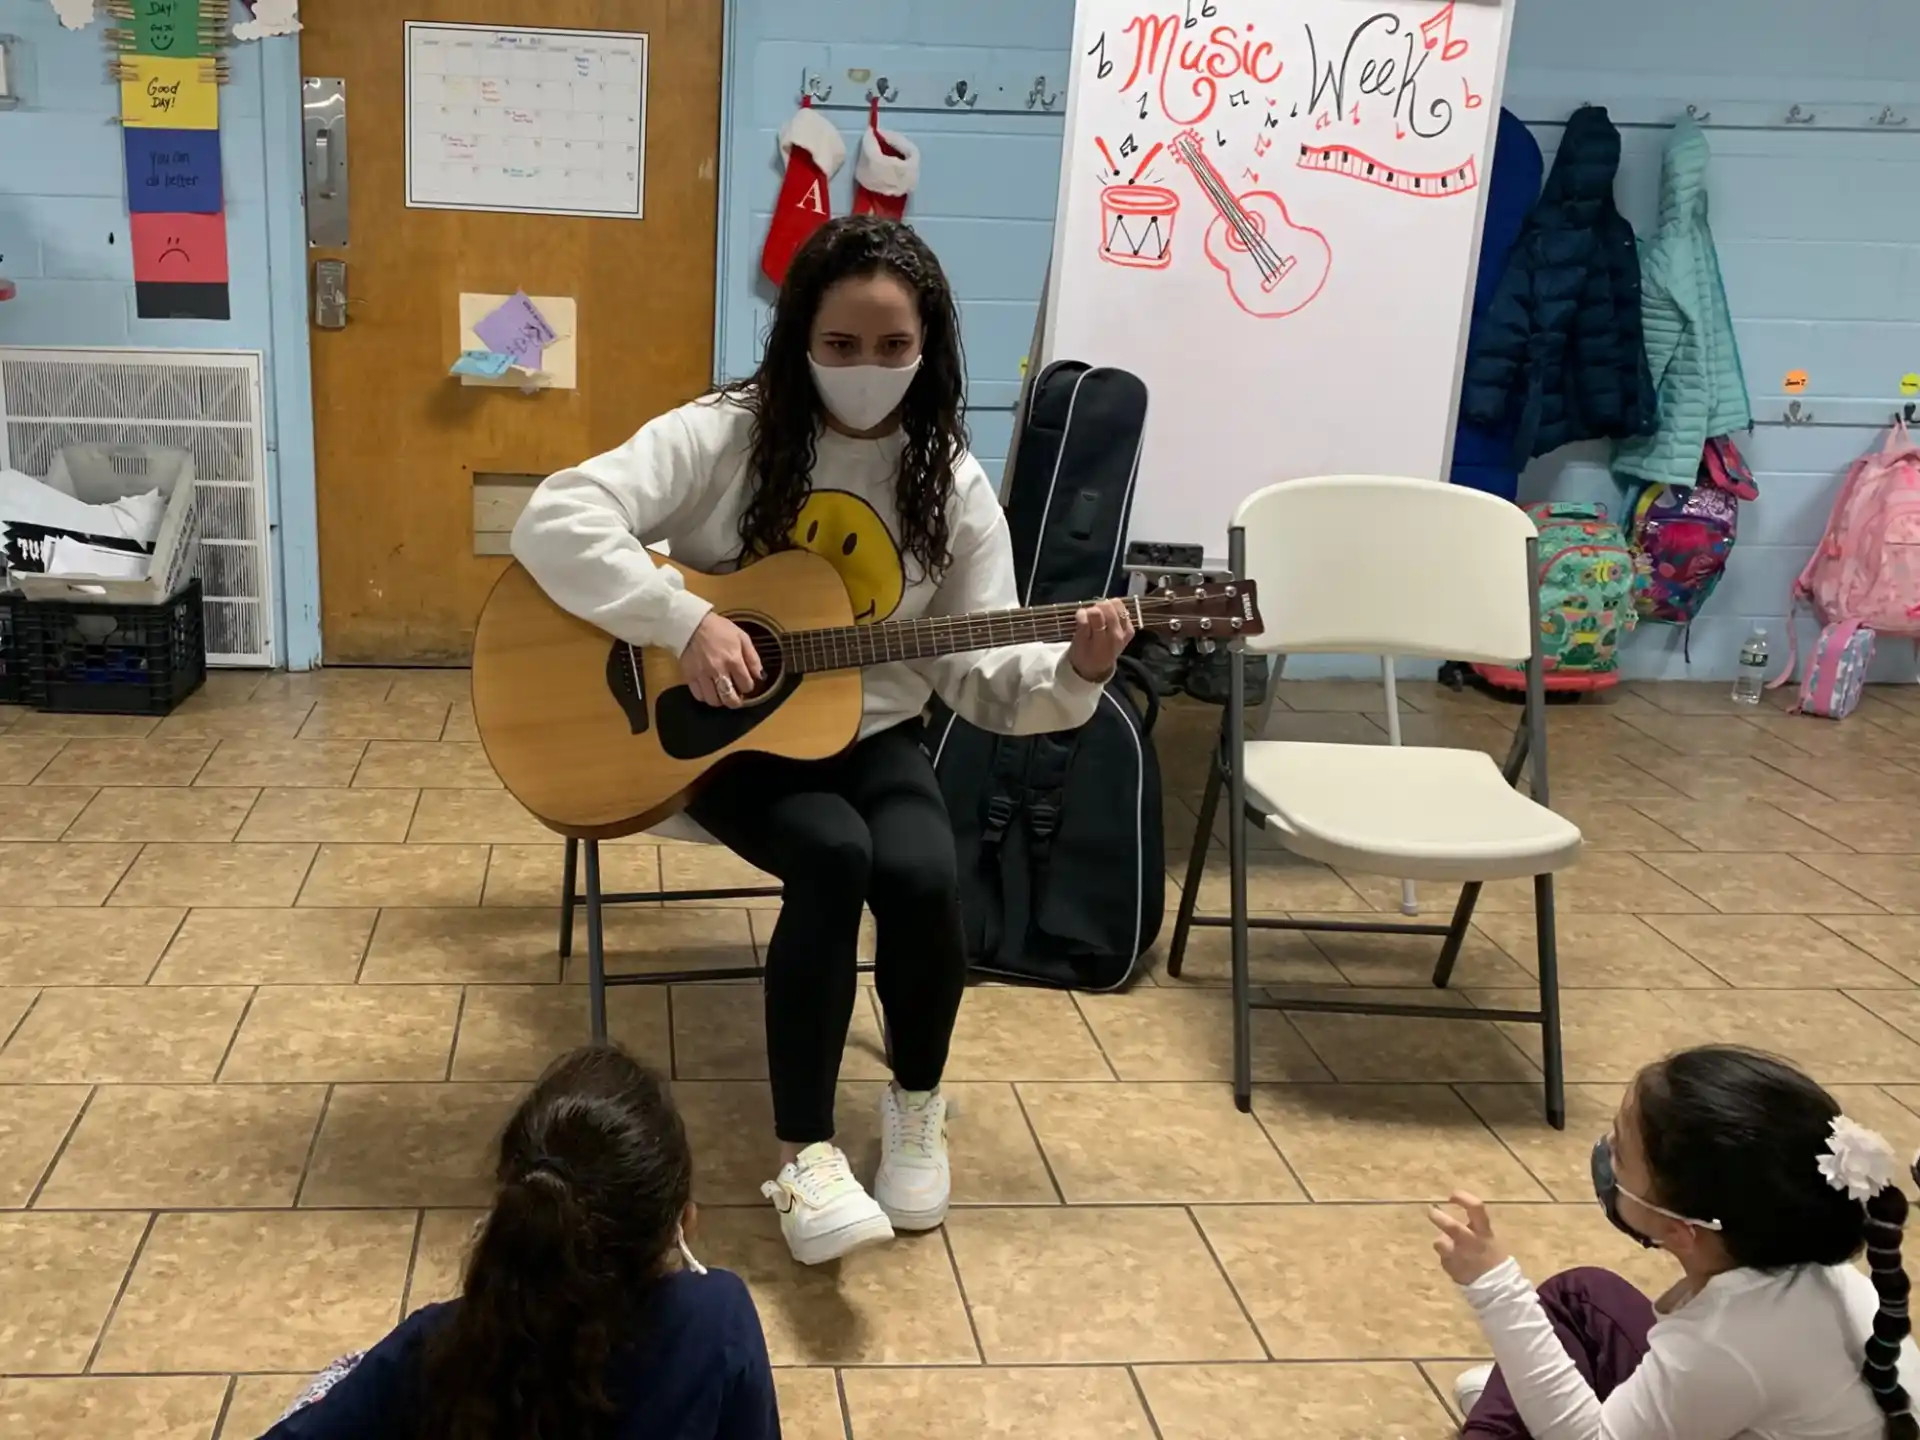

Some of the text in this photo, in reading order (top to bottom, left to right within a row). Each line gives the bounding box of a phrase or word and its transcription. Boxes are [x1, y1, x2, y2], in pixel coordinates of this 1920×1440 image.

[147, 76, 180, 96] Good
[1119, 14, 1283, 125] Music
[796, 178, 827, 216] A
